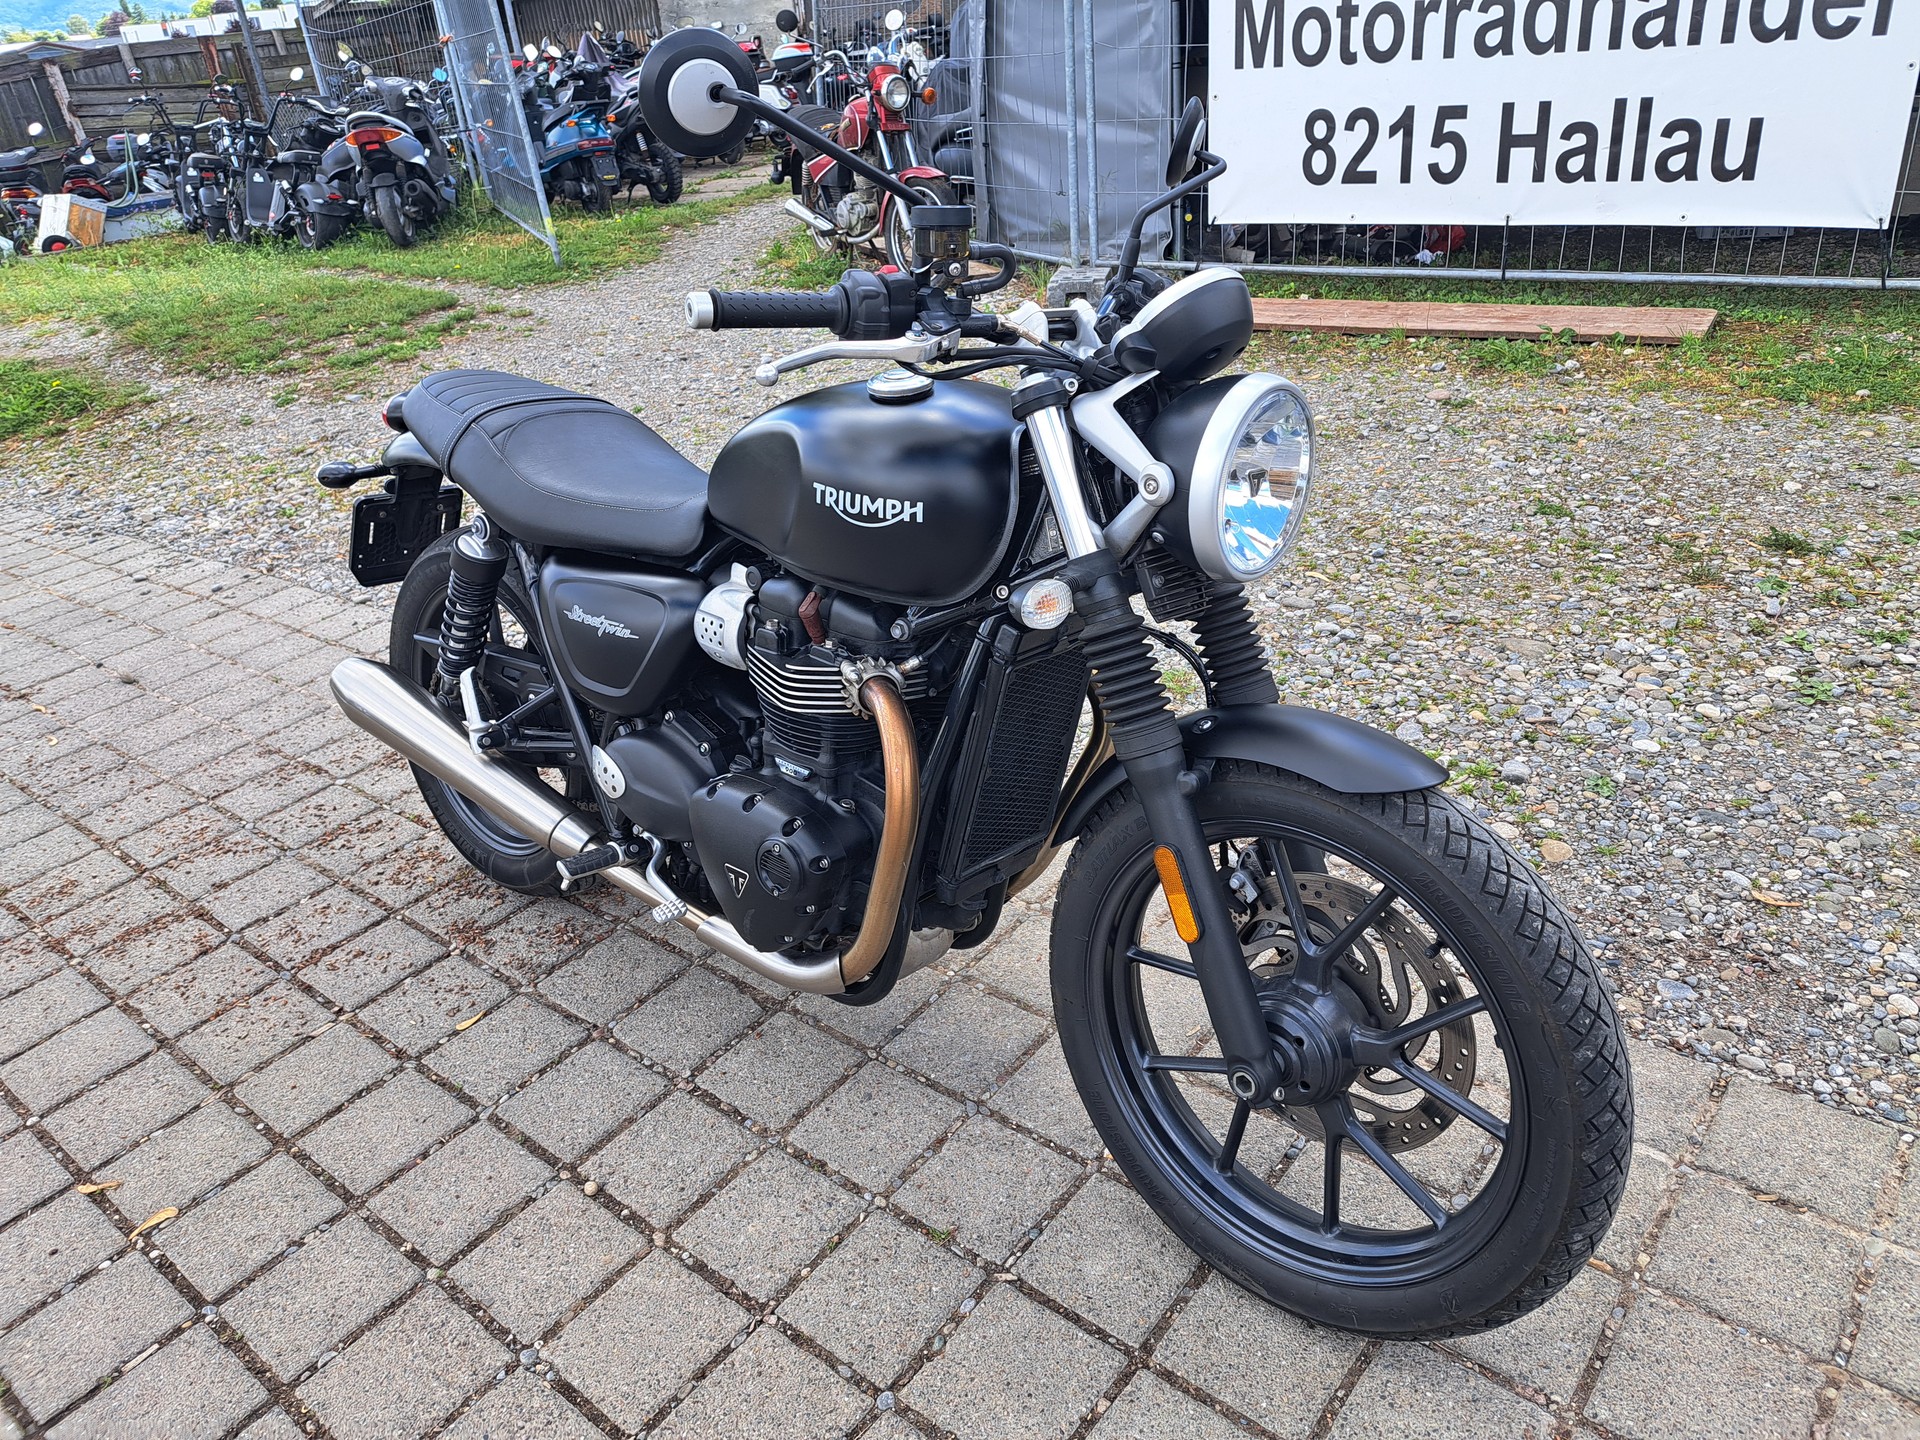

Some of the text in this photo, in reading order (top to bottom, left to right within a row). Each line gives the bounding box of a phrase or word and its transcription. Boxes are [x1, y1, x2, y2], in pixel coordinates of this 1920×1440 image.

[1302, 97, 1764, 186] 8215 Hallau
[813, 481, 923, 527] TRIUMPH
[1412, 871, 1531, 1014] BRIDGESTONE
